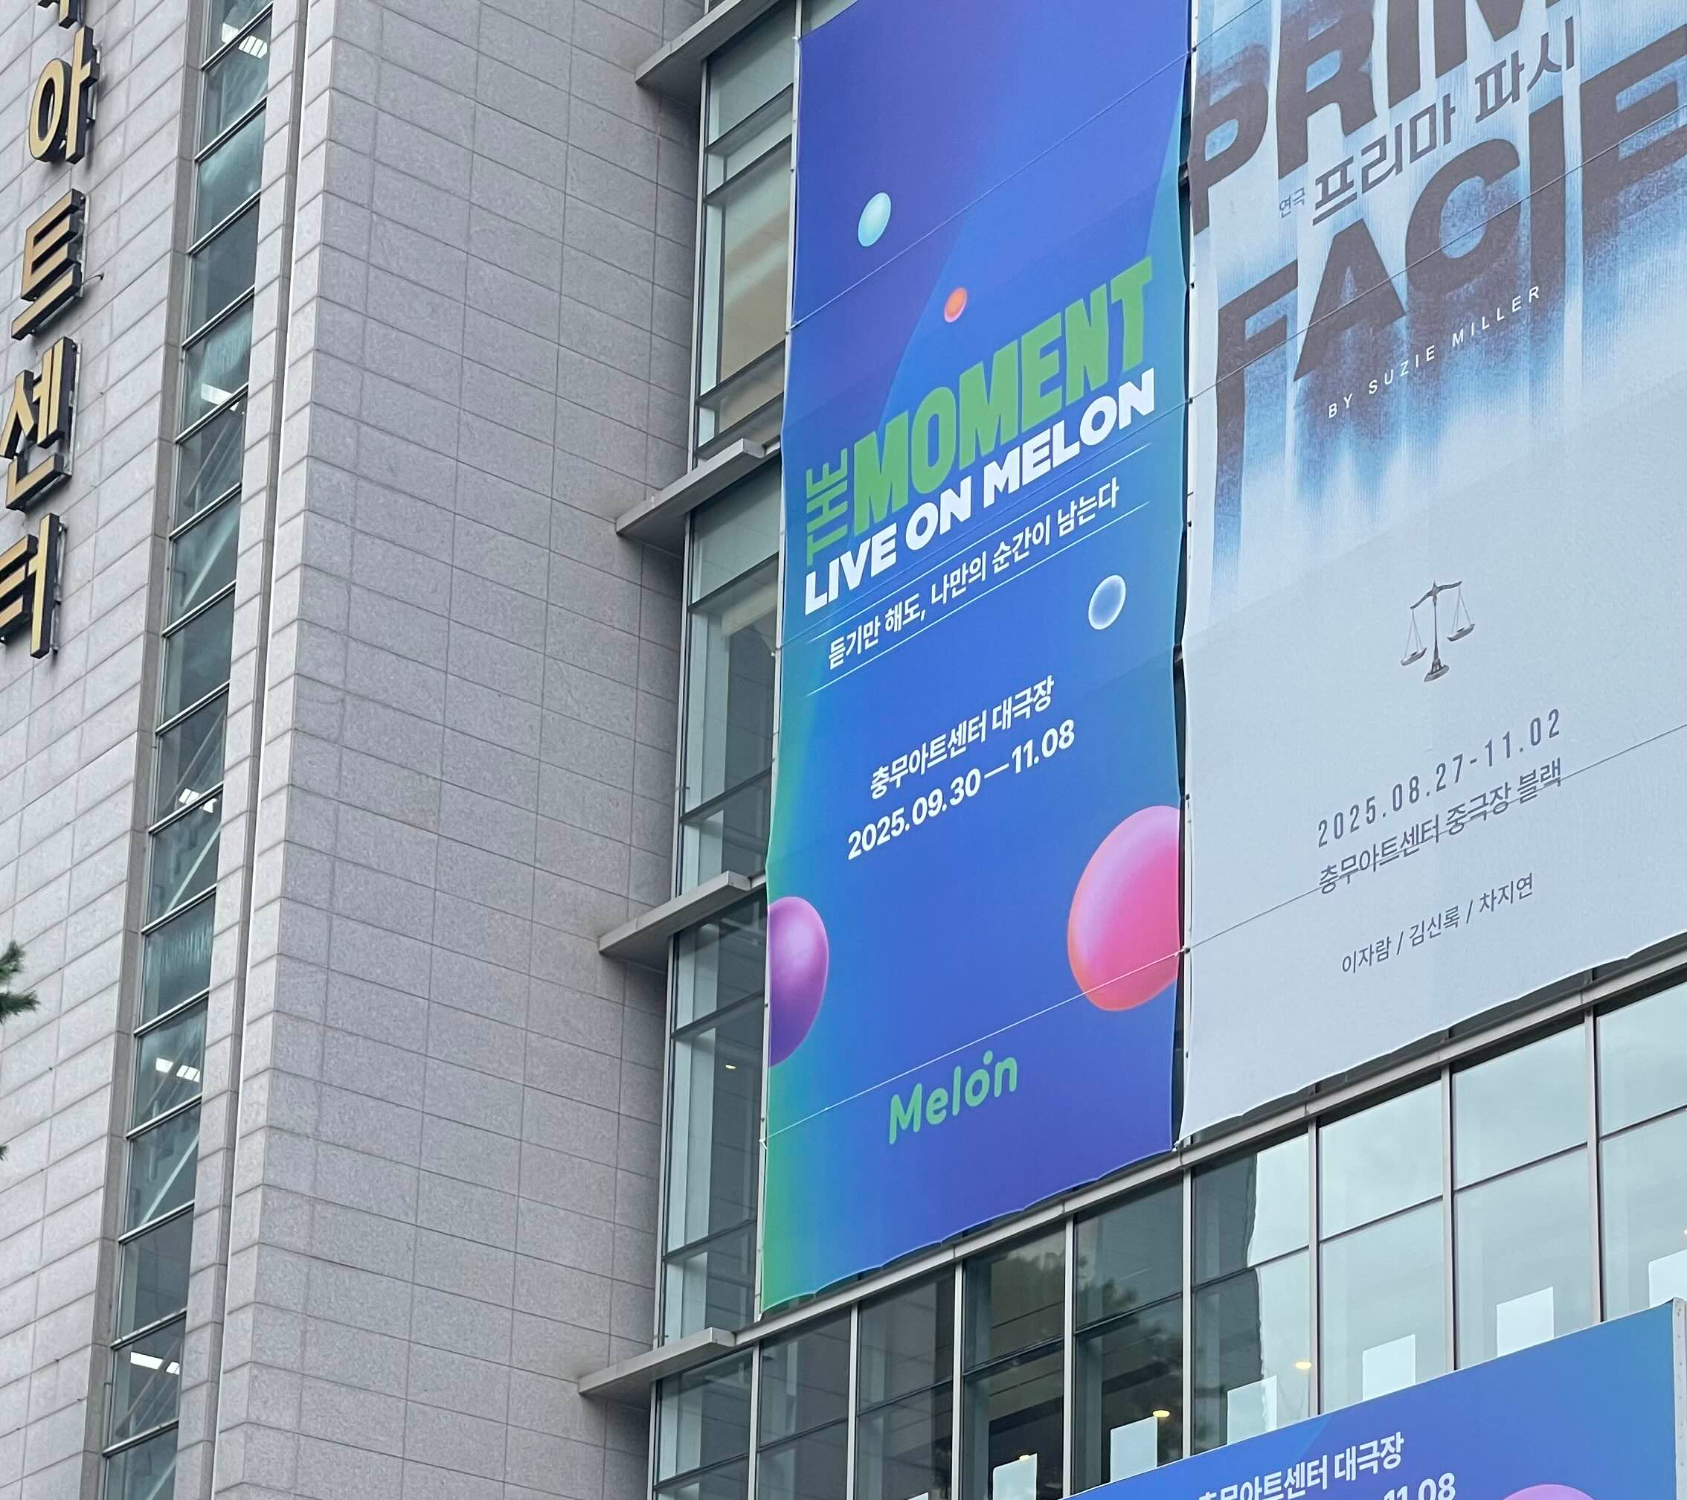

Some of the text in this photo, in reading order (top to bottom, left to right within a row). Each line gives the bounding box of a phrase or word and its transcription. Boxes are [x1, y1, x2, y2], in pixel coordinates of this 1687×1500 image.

[1279, 16, 1576, 226] 연극 프리마 파시
[0, 0, 97, 658] 아트센터
[1328, 285, 1541, 418] BY SUZIE MILLER
[806, 256, 1153, 567] THE MOMENT
[804, 368, 1155, 616] LIVE ON MELON
[828, 477, 1120, 670] 듣기만 해도, 나만의 순간이 남는다
[870, 674, 1055, 800] 충무아트센터 대극장
[1318, 709, 1560, 848] 2025.08.27-11.02
[1319, 815, 1440, 894] 충무아트센터
[1446, 782, 1511, 835] 중극장
[1342, 936, 1392, 973] 이자람
[1409, 905, 1460, 946] 김신록
[1479, 872, 1533, 913] 차지연
[889, 1050, 1018, 1145] Melon
[1334, 1431, 1404, 1481] 대극장
